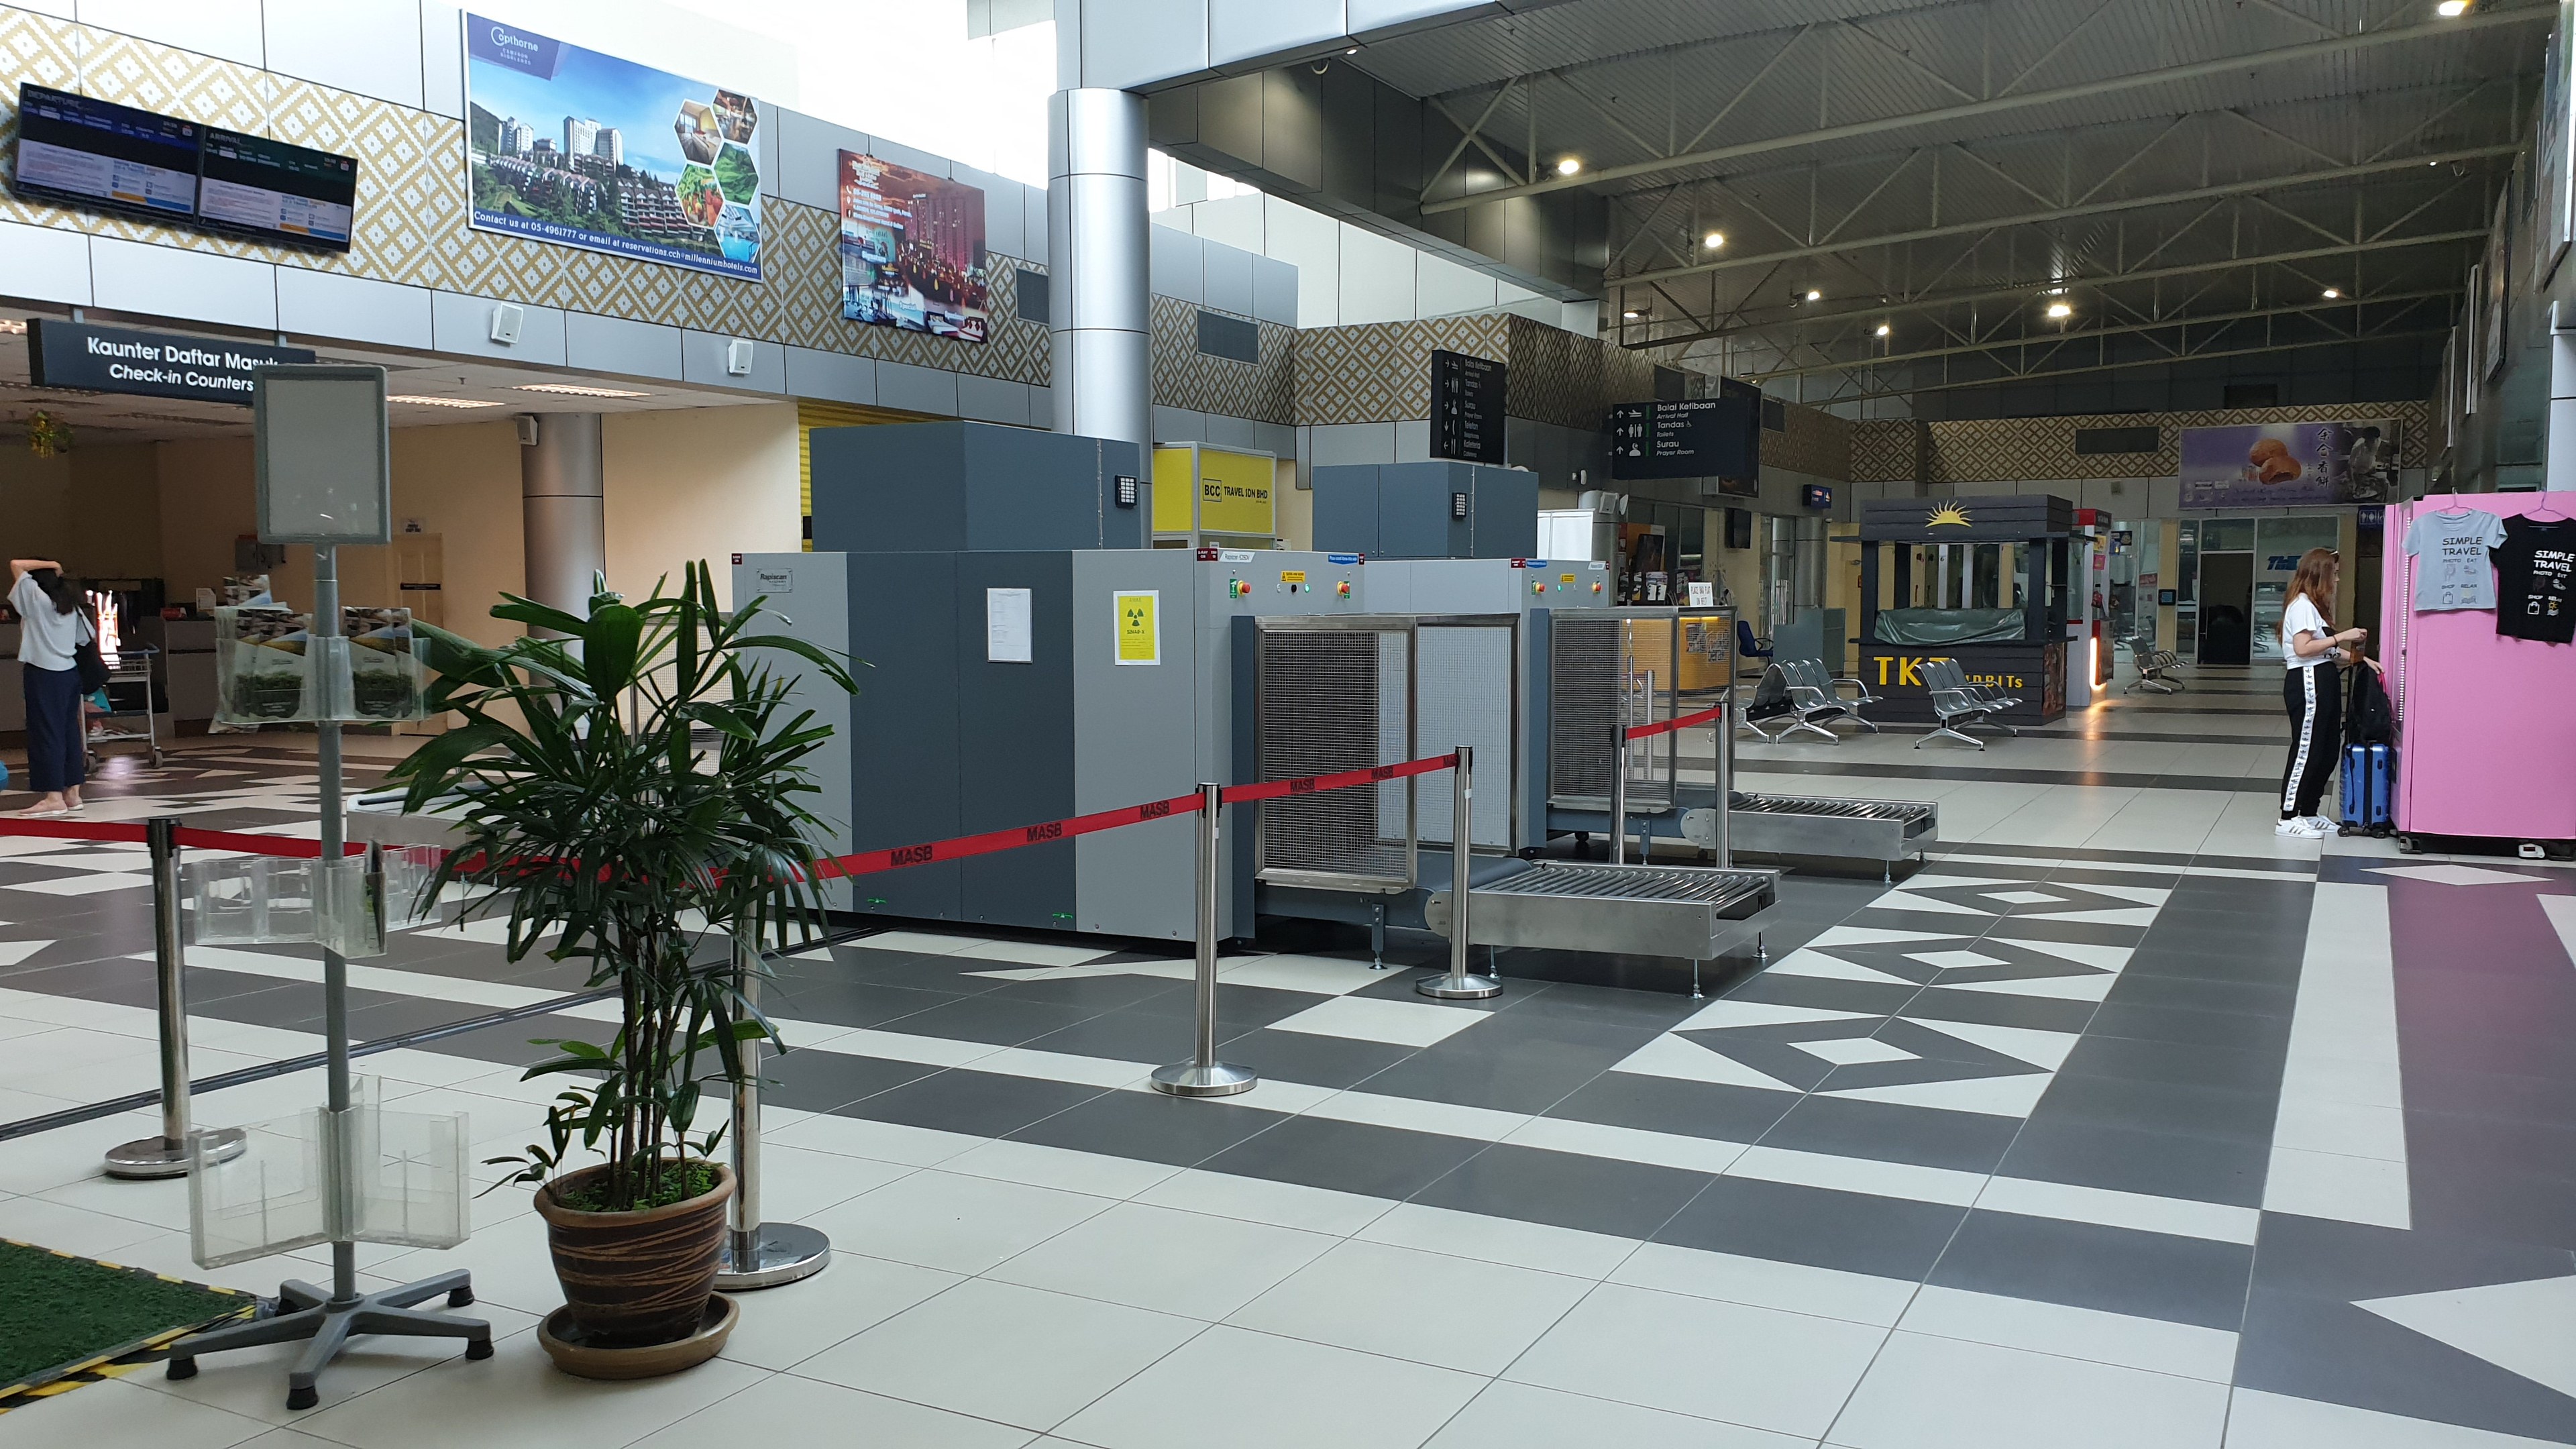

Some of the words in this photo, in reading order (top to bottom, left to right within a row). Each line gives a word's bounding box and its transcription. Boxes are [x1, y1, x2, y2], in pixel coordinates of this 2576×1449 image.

[490, 26, 539, 52] Copthorne
[474, 211, 506, 225] Contact
[509, 219, 519, 227] us
[531, 221, 578, 239] 05-4961777
[578, 233, 588, 241] or
[589, 234, 611, 244] email
[612, 238, 621, 247] at
[87, 336, 160, 361] Kaunter
[165, 345, 221, 368] Daftar
[109, 363, 182, 384] Check-in
[185, 371, 254, 392] Counters
[1657, 403, 1677, 412] Balai
[1679, 402, 1716, 411] Ketibaan
[1656, 440, 1679, 448] Surau
[1204, 484, 1220, 497] BCC
[1224, 486, 1244, 497] TRAVEL
[1245, 488, 1256, 498] SDN
[1256, 489, 1268, 499] BHD
[2442, 536, 2483, 545] SIMPLE
[2442, 547, 2482, 555] TRAVEL
[2534, 550, 2575, 563] SIMPLE
[2533, 559, 2573, 572] TRAVEL
[1873, 657, 1949, 686] TK
[1371, 766, 1394, 780] MASB
[1290, 777, 1315, 793] MASB
[1140, 800, 1171, 820] MASB
[1026, 822, 1063, 843] MASB
[890, 845, 933, 867] MASB
